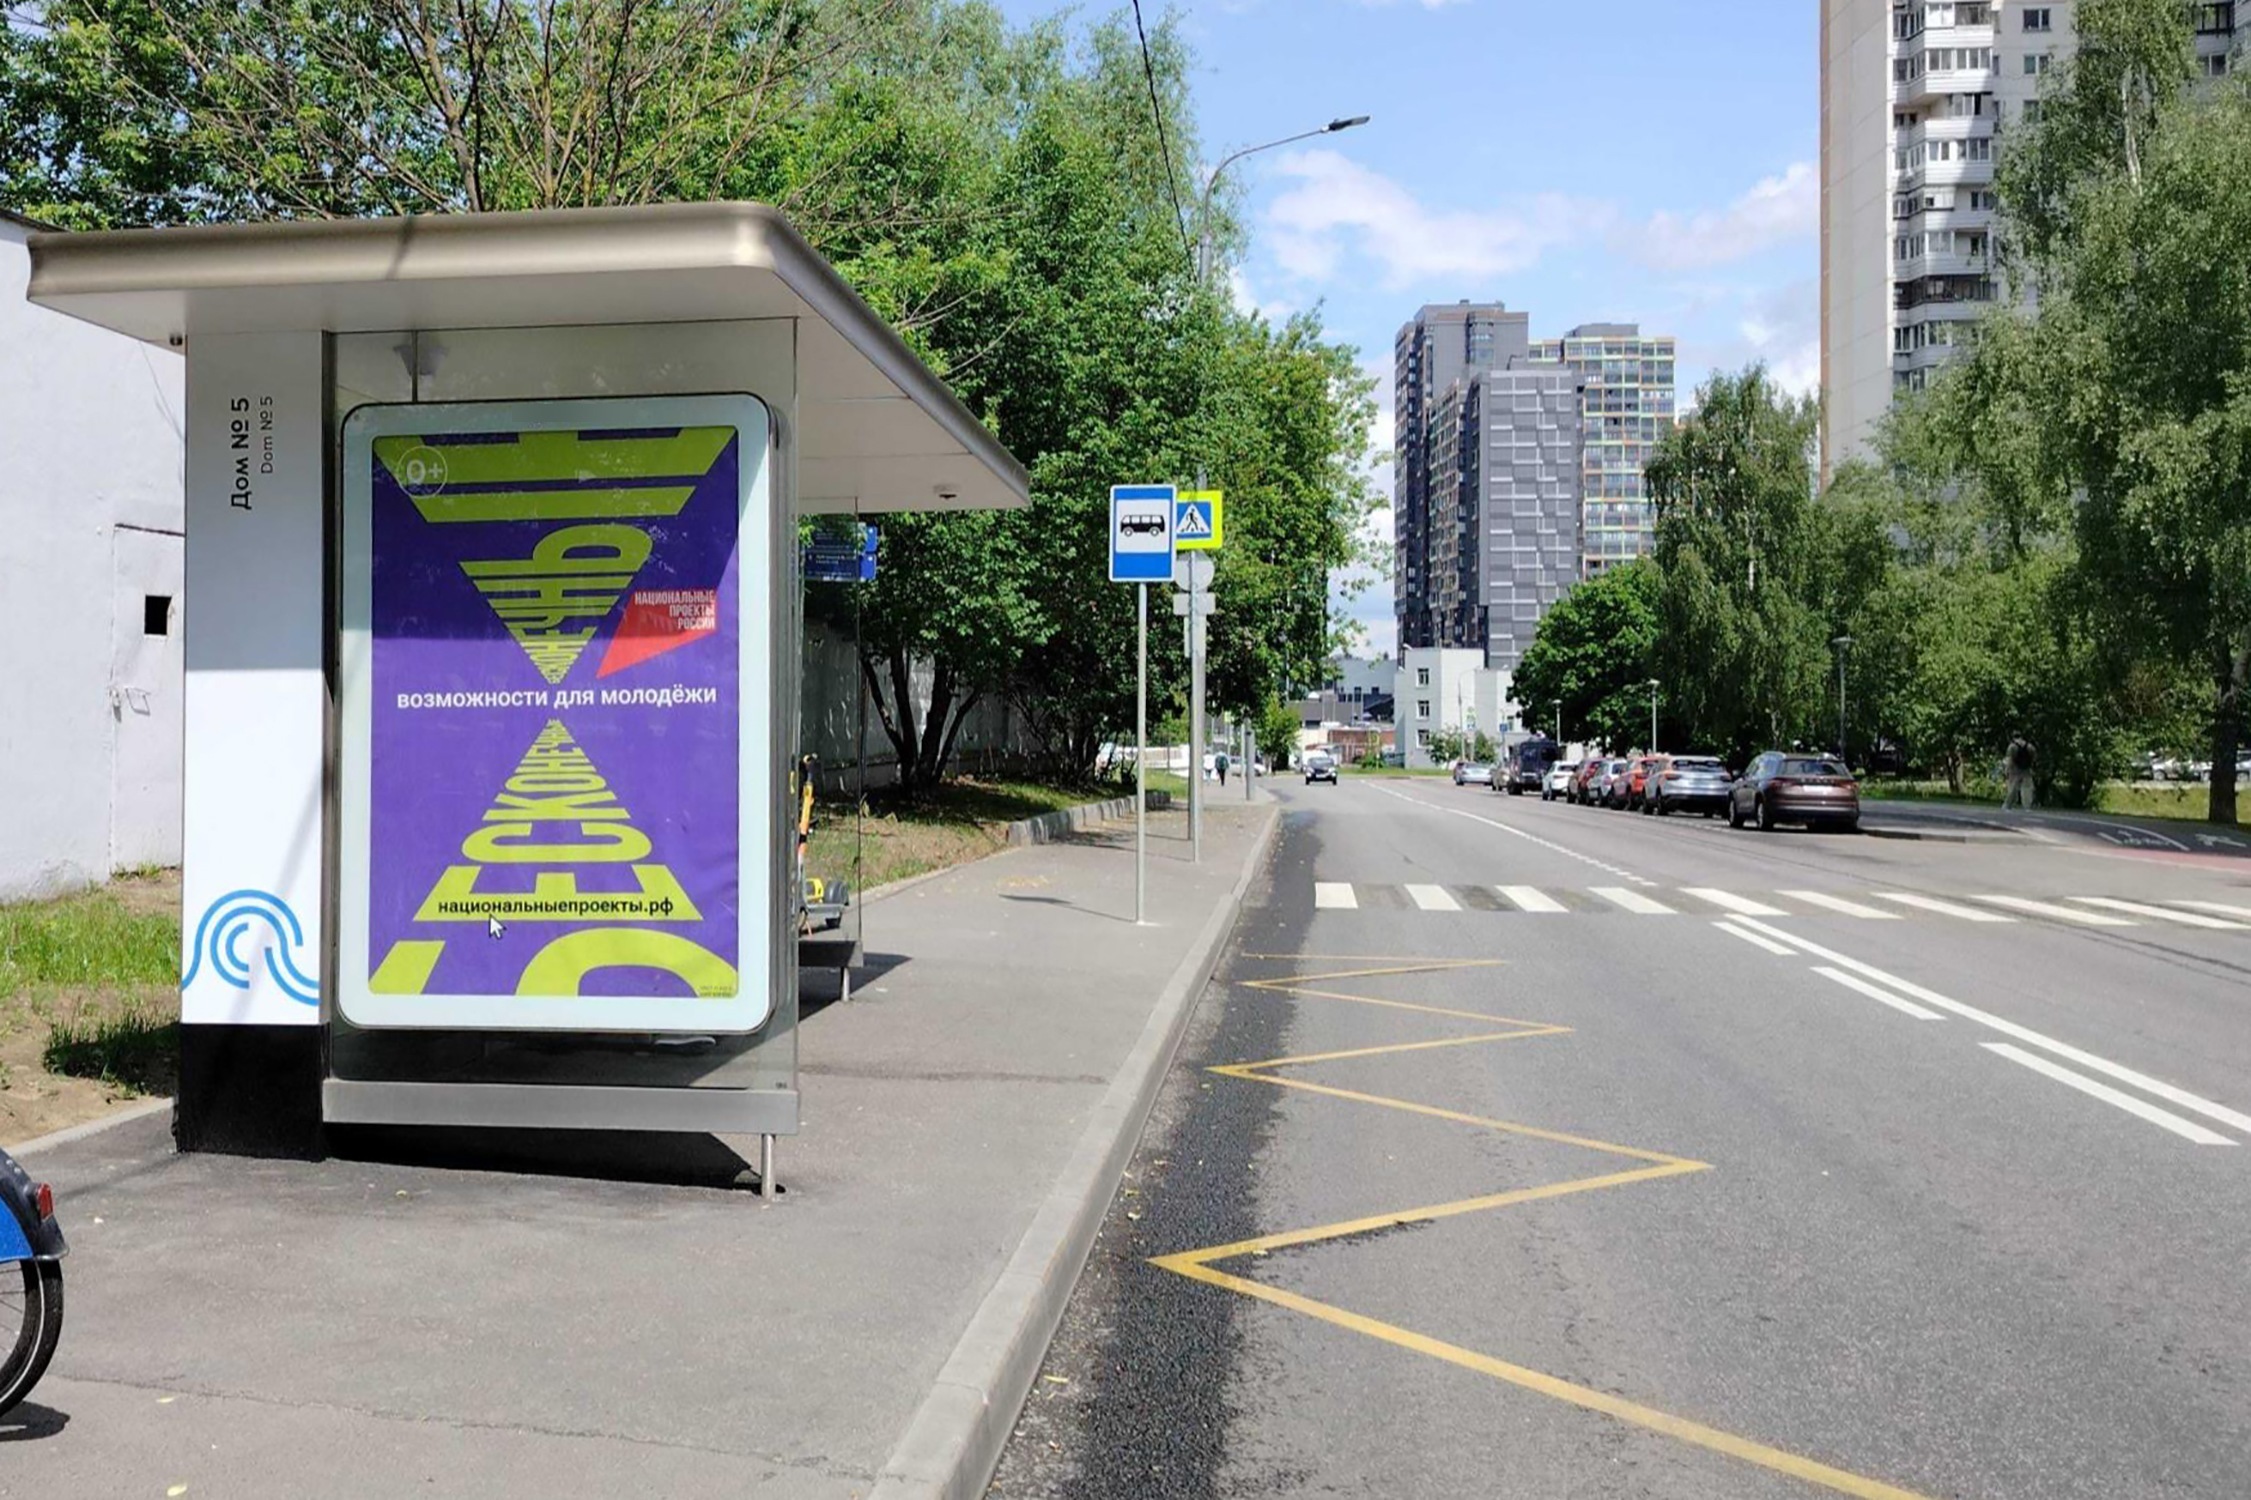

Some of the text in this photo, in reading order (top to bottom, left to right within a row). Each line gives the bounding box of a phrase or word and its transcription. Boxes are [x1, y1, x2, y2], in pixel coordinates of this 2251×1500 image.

[231, 398, 249, 412] 5
[260, 395, 273, 406] 5
[260, 435, 273, 474] Dom
[406, 459, 443, 486] 0+
[231, 456, 252, 510] Дом
[635, 590, 715, 605] НАЦИОНАЛЬНЫЕ
[669, 604, 715, 617] ПРОЕКТЫ
[677, 616, 715, 630] РОССИИ
[397, 684, 718, 710] возможности для молодёжи
[438, 896, 674, 916] национальныепроекты.рф
